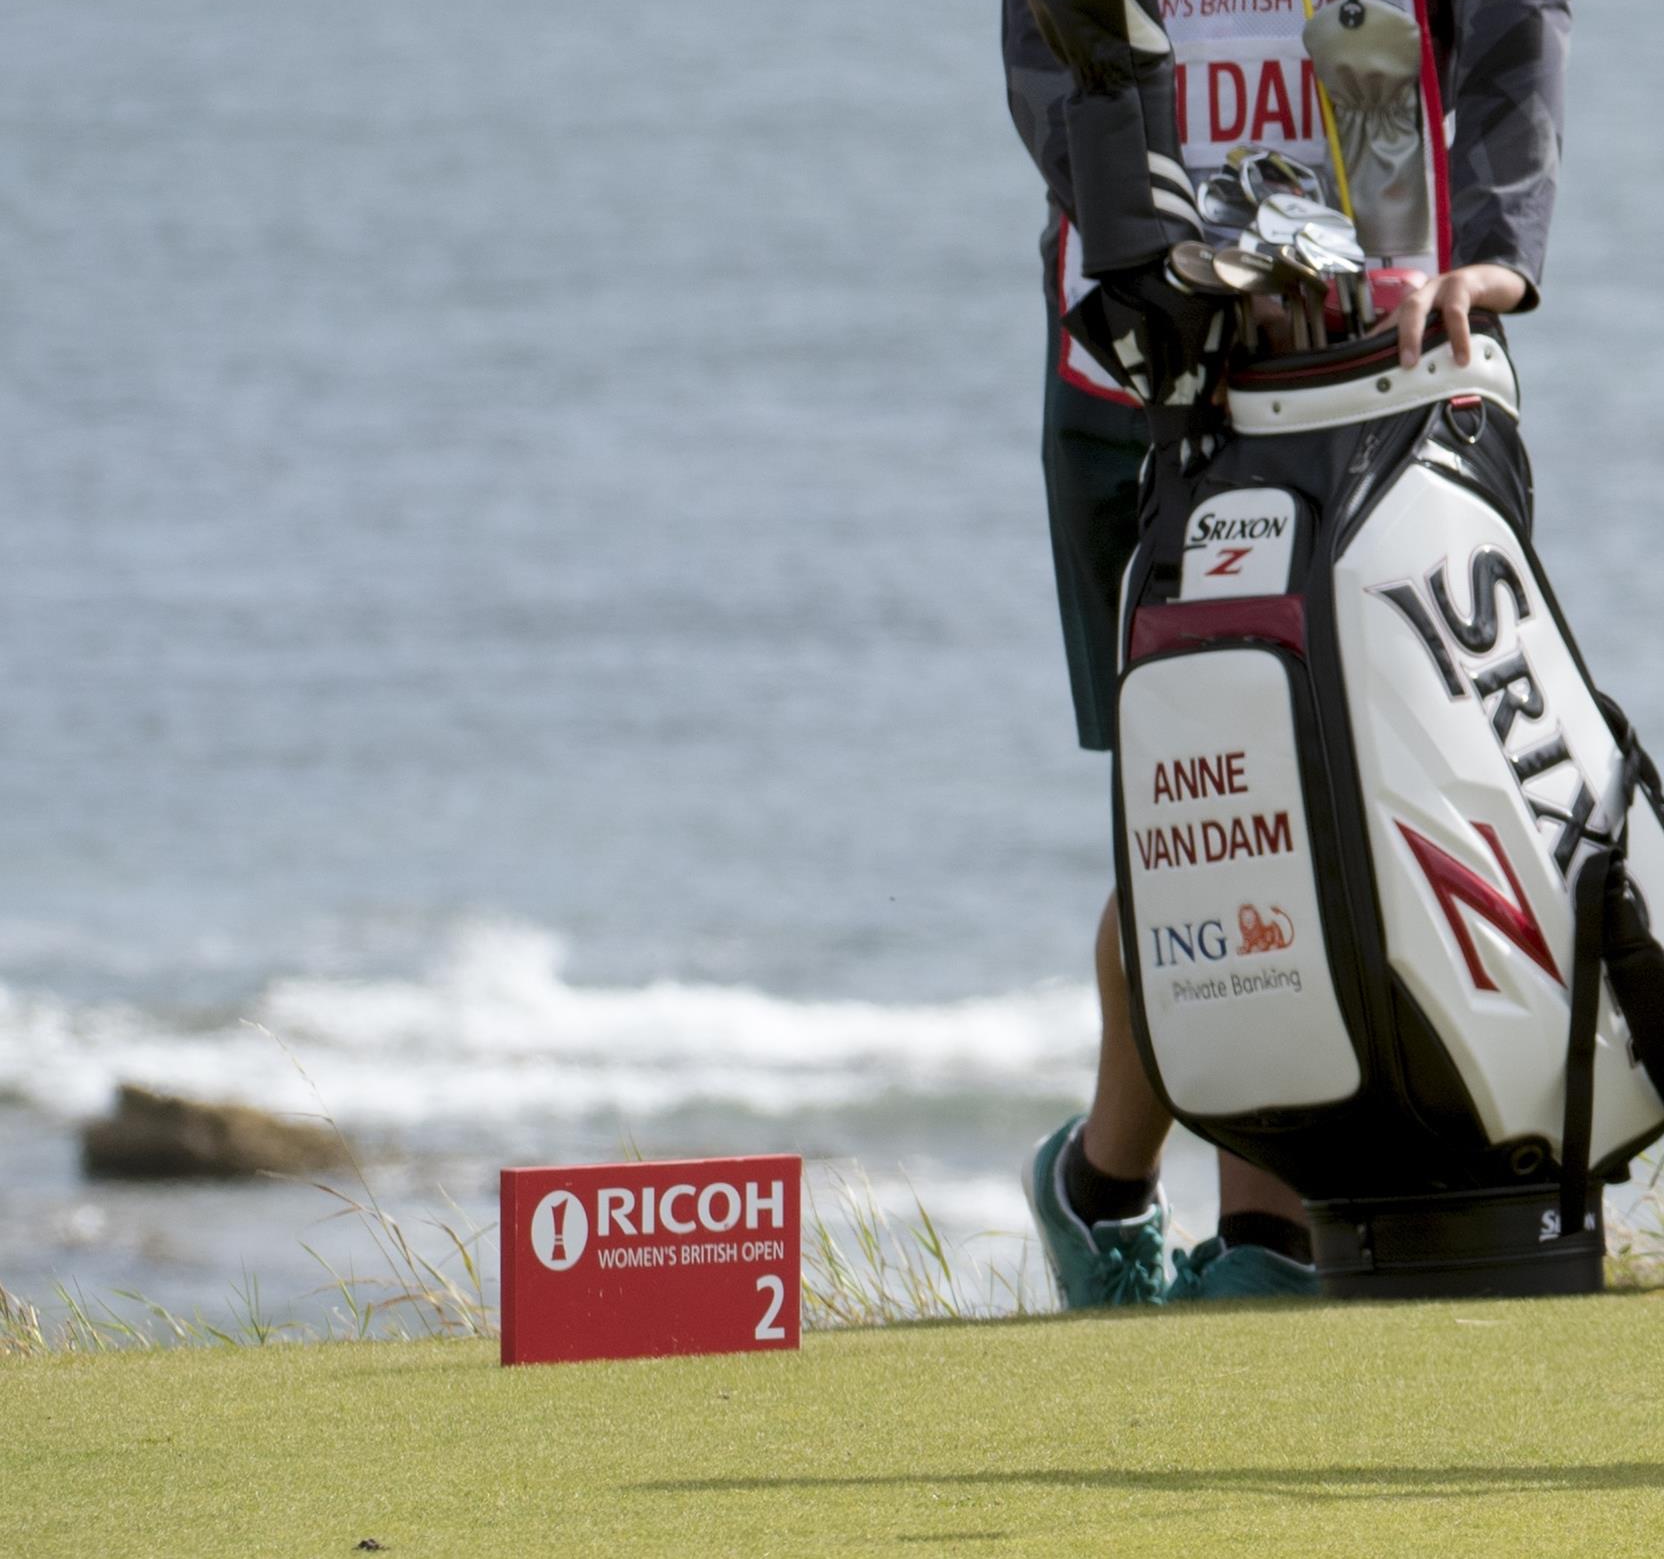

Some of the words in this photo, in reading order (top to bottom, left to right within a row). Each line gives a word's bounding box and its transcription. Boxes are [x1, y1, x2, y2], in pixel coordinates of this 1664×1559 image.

[1204, 547, 1253, 576] Z
[1154, 752, 1248, 804] ANNE
[1135, 822, 1198, 871] VAN
[1201, 811, 1294, 863] DAM
[1151, 919, 1228, 967] ING
[1173, 979, 1227, 1003] Private
[1230, 968, 1302, 997] Banking
[597, 1180, 784, 1236] RICOH
[598, 1246, 677, 1270] WOMEN'S
[681, 1243, 738, 1264] BRITISH
[741, 1240, 784, 1261] OPEN
[755, 1274, 785, 1340] 2
